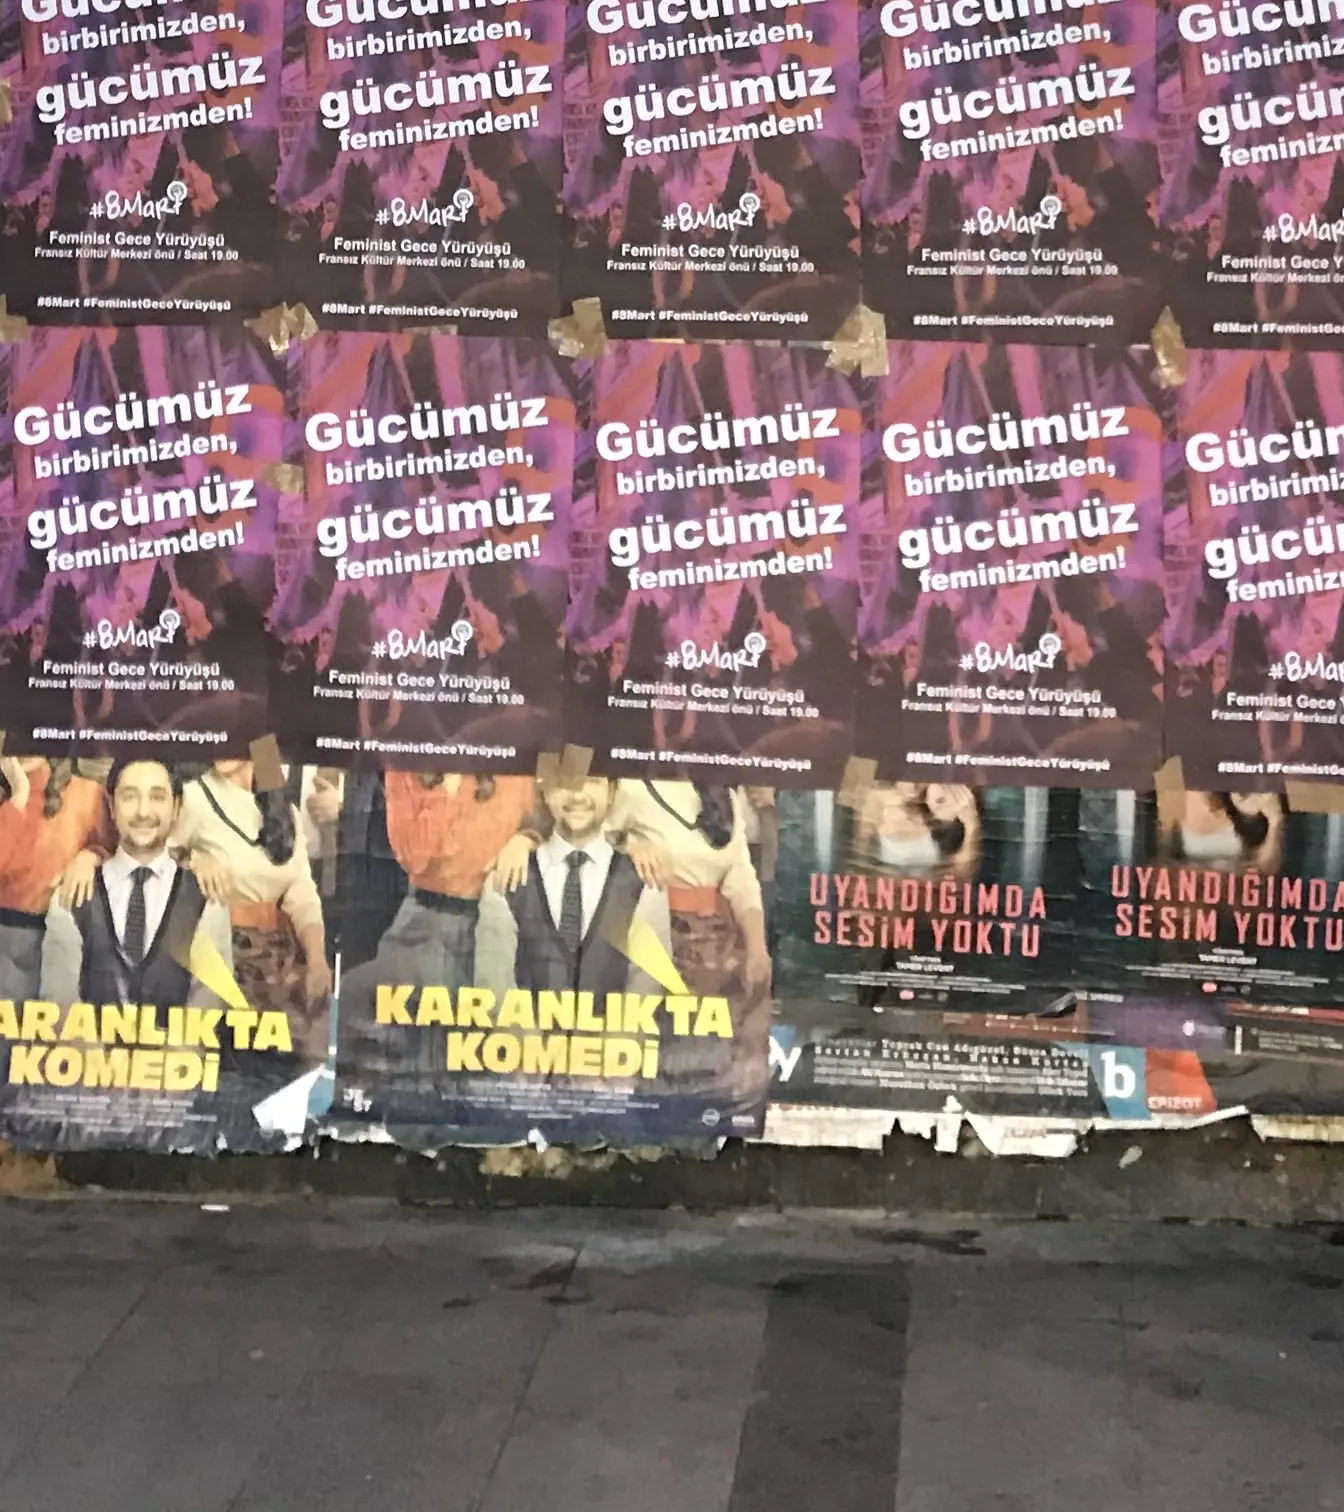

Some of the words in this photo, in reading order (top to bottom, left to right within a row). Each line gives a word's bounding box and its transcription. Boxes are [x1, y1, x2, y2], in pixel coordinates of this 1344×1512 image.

[42, 14, 245, 55] birbirimizden,
[327, 20, 531, 60] birbirimizden,
[608, 22, 813, 67] birbirimizden,
[904, 23, 1111, 70] birbirimizden,
[36, 55, 265, 124] gücümüz
[319, 63, 552, 129] gücümüz
[602, 64, 836, 135] gücümüz
[898, 63, 1135, 140] gücümüz
[54, 97, 253, 146] feminizmden!
[338, 106, 540, 152] feminizmden!
[623, 108, 824, 158] feminizmden!
[920, 109, 1124, 162] feminizmden!
[621, 244, 684, 259] Feminist
[688, 244, 724, 259] Gece
[728, 244, 799, 260] Yürüyüşü
[12, 379, 253, 445] Gücümüz
[304, 391, 549, 452] Gücümüz
[595, 402, 840, 462] Gücümüz
[881, 402, 1129, 463] Gücümüz
[34, 434, 238, 479] birbirimizden,
[325, 444, 533, 486] birbirimizden,
[616, 452, 826, 496] birbirimizden,
[904, 454, 1116, 498] birbirimizden,
[26, 474, 257, 550] gücümüz
[316, 486, 554, 558] gücümüz
[608, 498, 847, 568] gücümüz
[897, 497, 1139, 569] gücümüz
[46, 522, 245, 572] feminizmden!
[336, 535, 541, 581] feminizmden!
[628, 547, 833, 591] feminizmden!
[919, 546, 1126, 594] feminizmden!
[810, 872, 1047, 920] UYANDIĞIMDA
[931, 918, 1040, 958] YOKTU
[1235, 910, 1344, 953] YOKTU
[375, 984, 734, 1038] KARANLIKTA
